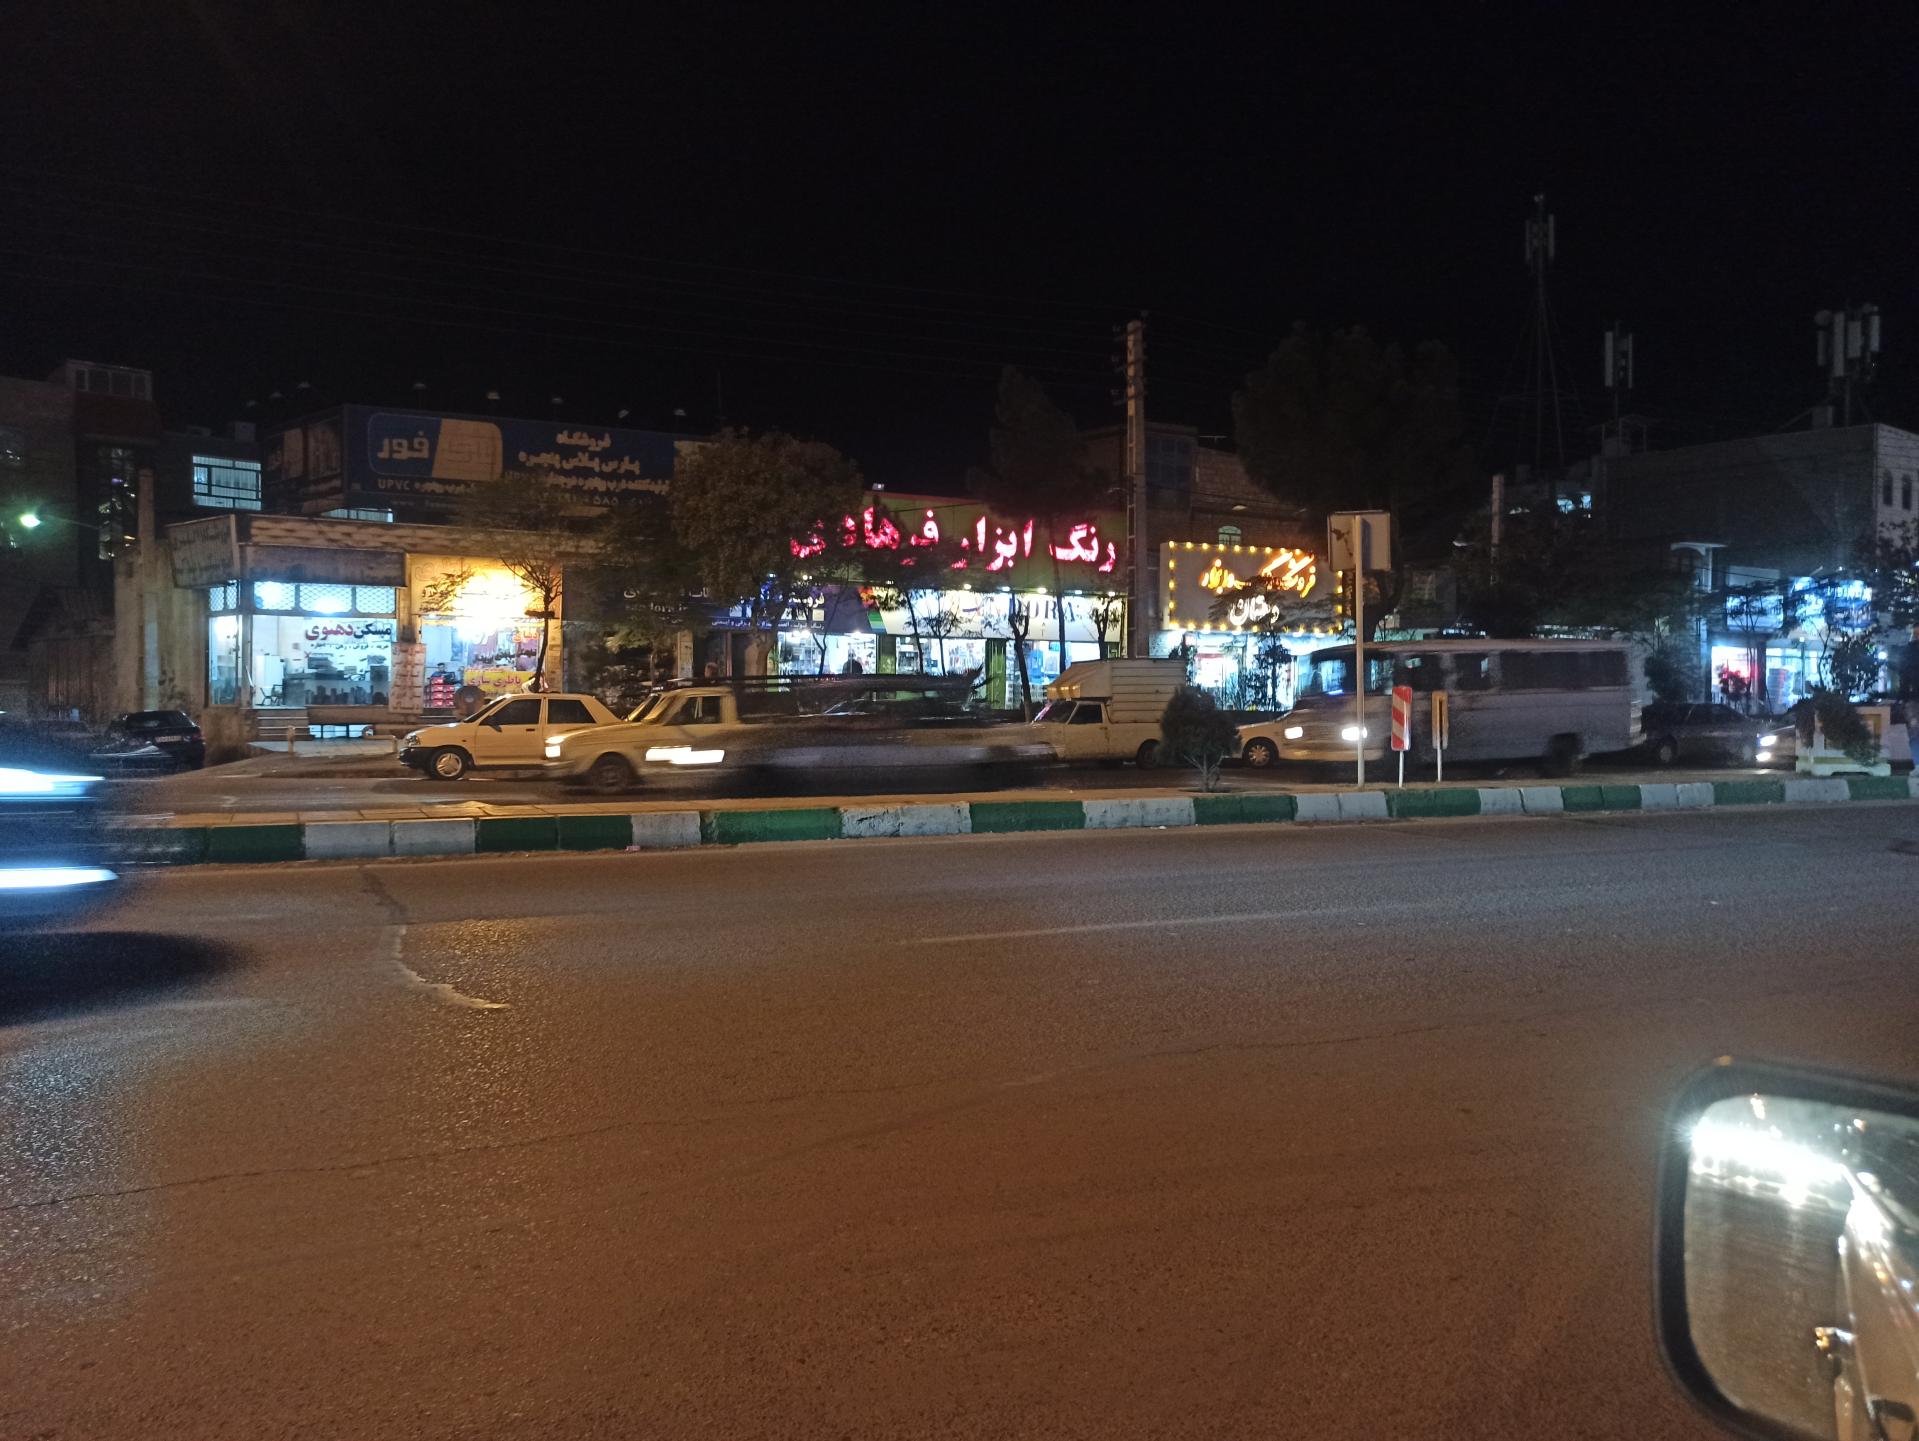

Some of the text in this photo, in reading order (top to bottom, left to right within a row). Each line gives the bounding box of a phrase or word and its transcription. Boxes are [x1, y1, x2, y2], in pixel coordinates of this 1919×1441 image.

[377, 430, 430, 459] فور
[377, 478, 411, 491] UPVC
[950, 514, 1034, 573] ابزار
[1048, 523, 1117, 573] رنگ
[353, 622, 392, 639] مسکن
